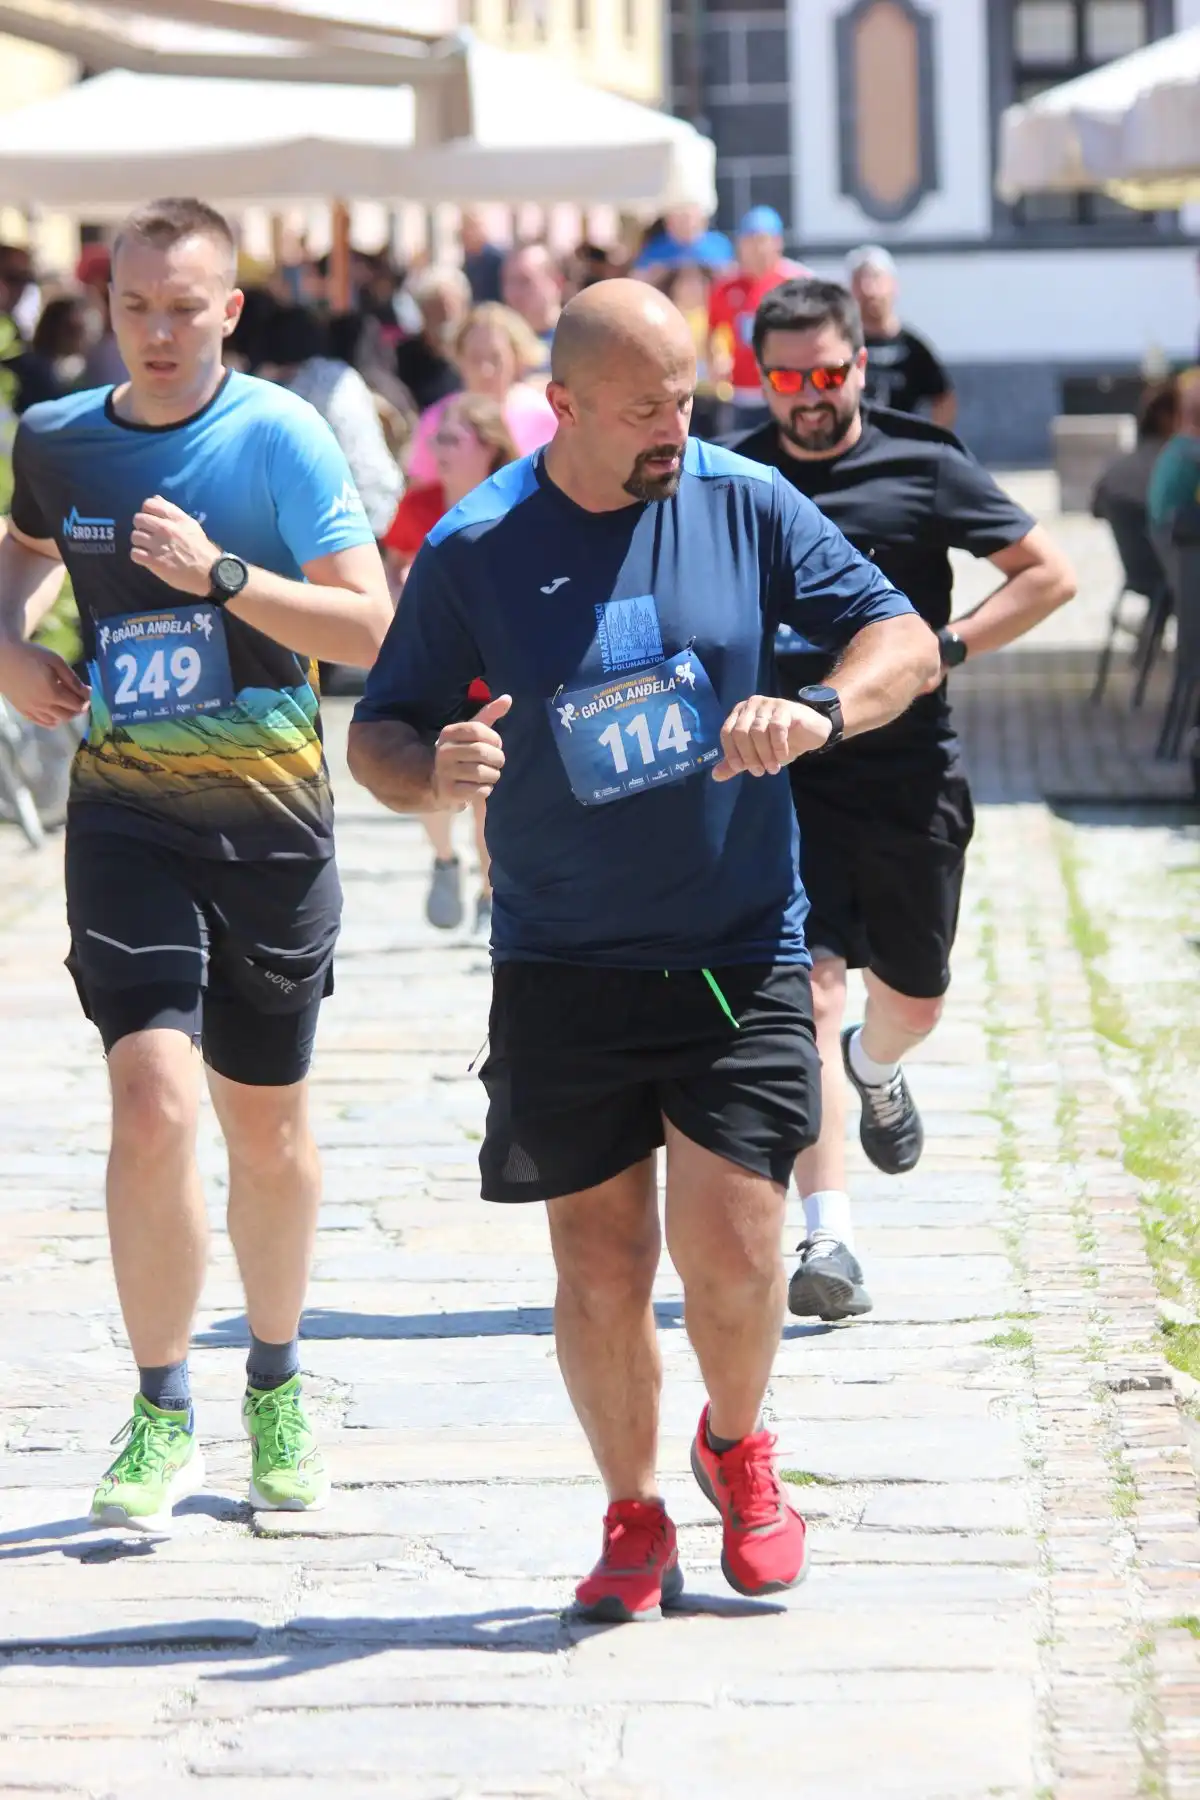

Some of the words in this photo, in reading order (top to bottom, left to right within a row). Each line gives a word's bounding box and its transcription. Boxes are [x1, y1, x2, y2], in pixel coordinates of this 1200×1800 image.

[73, 526, 115, 540] SRD315
[112, 623, 144, 643] GRADA
[147, 621, 191, 634] ANĐELA
[594, 603, 612, 674] VARAŽDINSKI
[114, 646, 201, 704] 249
[612, 655, 665, 672] POLUMARATON
[581, 693, 623, 719] GRADA
[626, 677, 676, 701] ANĐELA
[598, 703, 692, 773] 114
